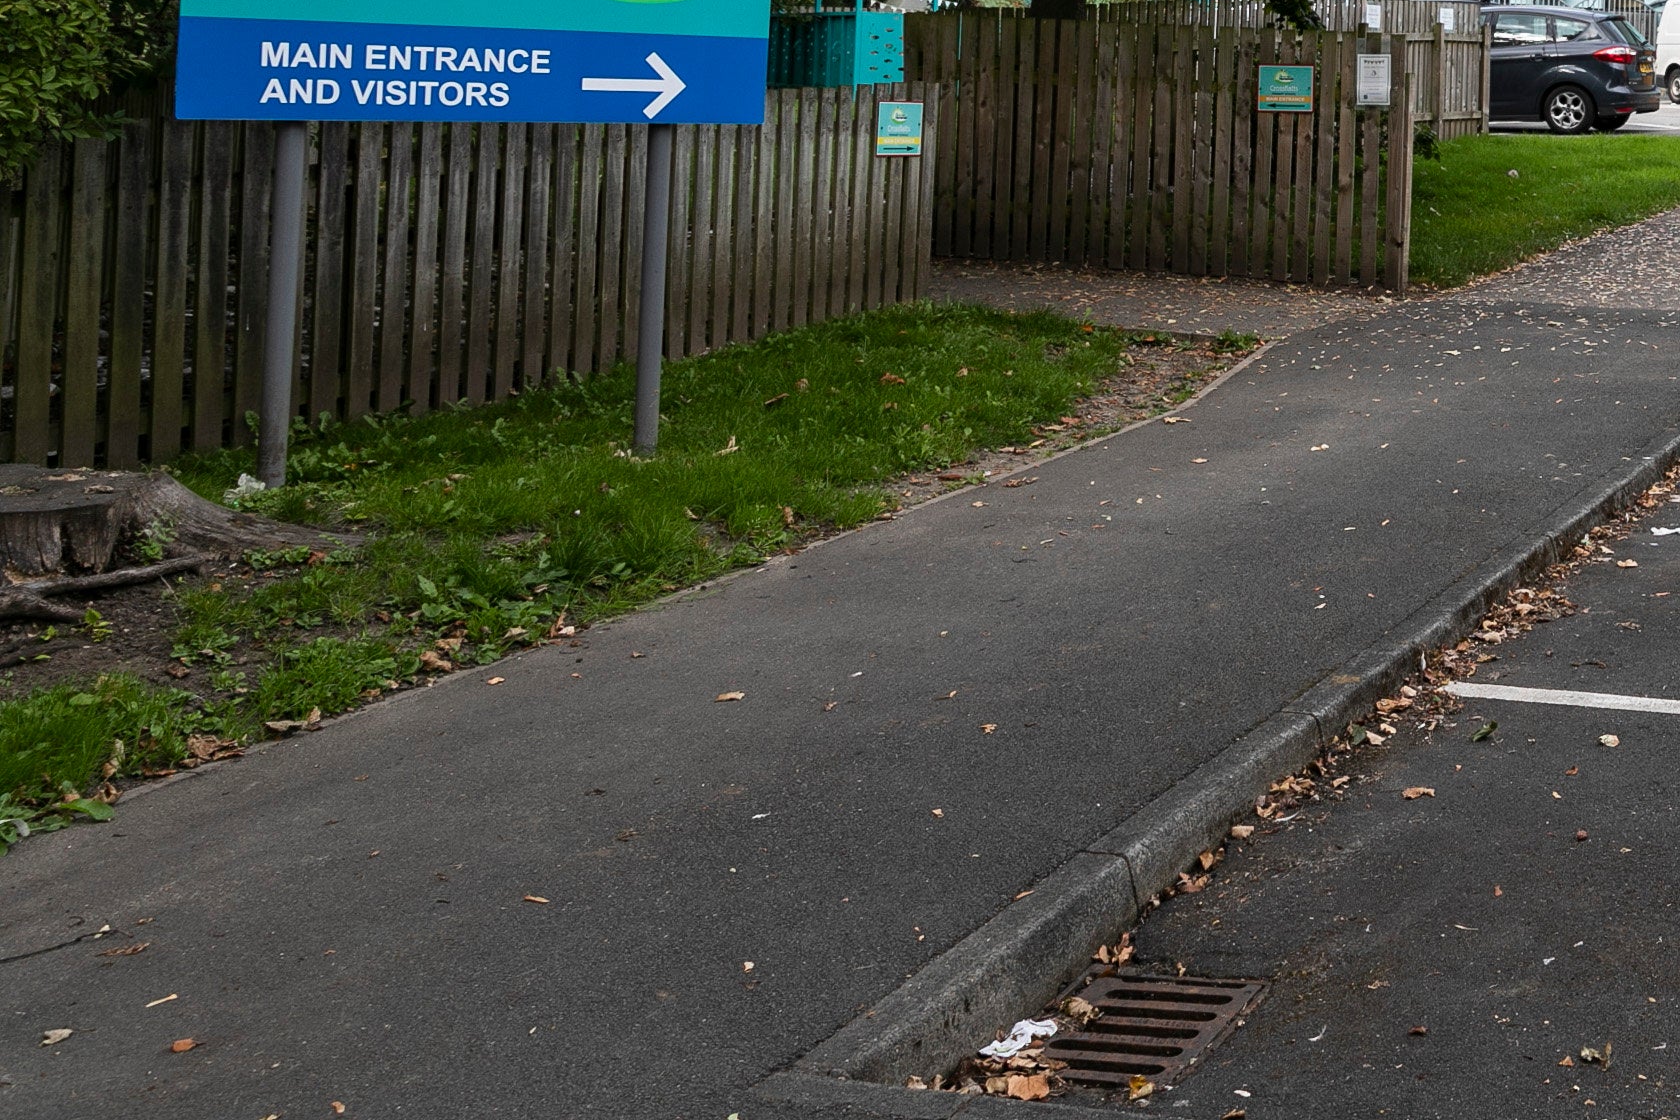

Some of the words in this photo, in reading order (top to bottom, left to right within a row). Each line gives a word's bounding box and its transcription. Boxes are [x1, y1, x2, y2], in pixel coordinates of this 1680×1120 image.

[260, 41, 353, 69] MAIN
[365, 44, 551, 74] ENTRANCE
[259, 78, 340, 105] AND
[351, 80, 510, 107] VISITORS
